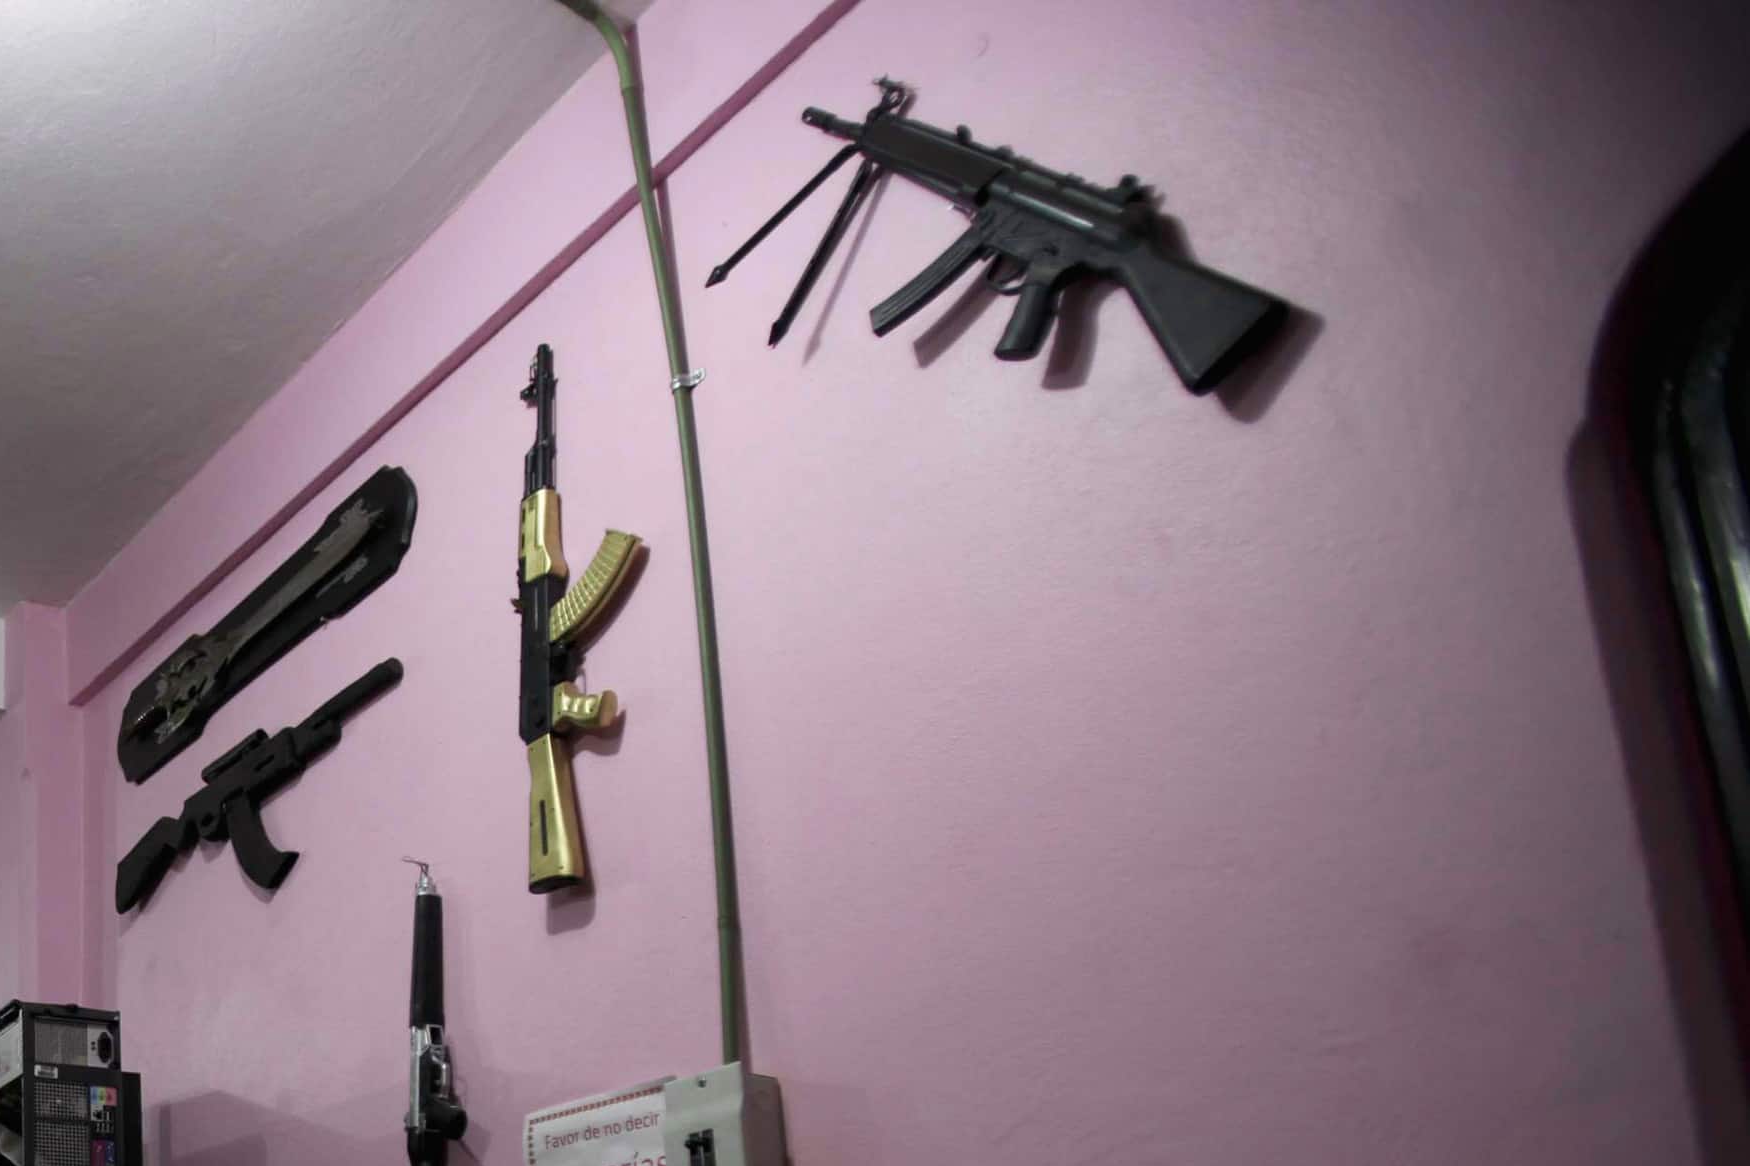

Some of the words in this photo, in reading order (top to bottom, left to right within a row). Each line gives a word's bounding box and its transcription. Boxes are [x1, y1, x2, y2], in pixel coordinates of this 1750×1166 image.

[545, 1131, 579, 1150] Favor
[584, 1125, 601, 1141] de
[604, 1122, 622, 1136] no
[625, 1112, 660, 1132] decir
